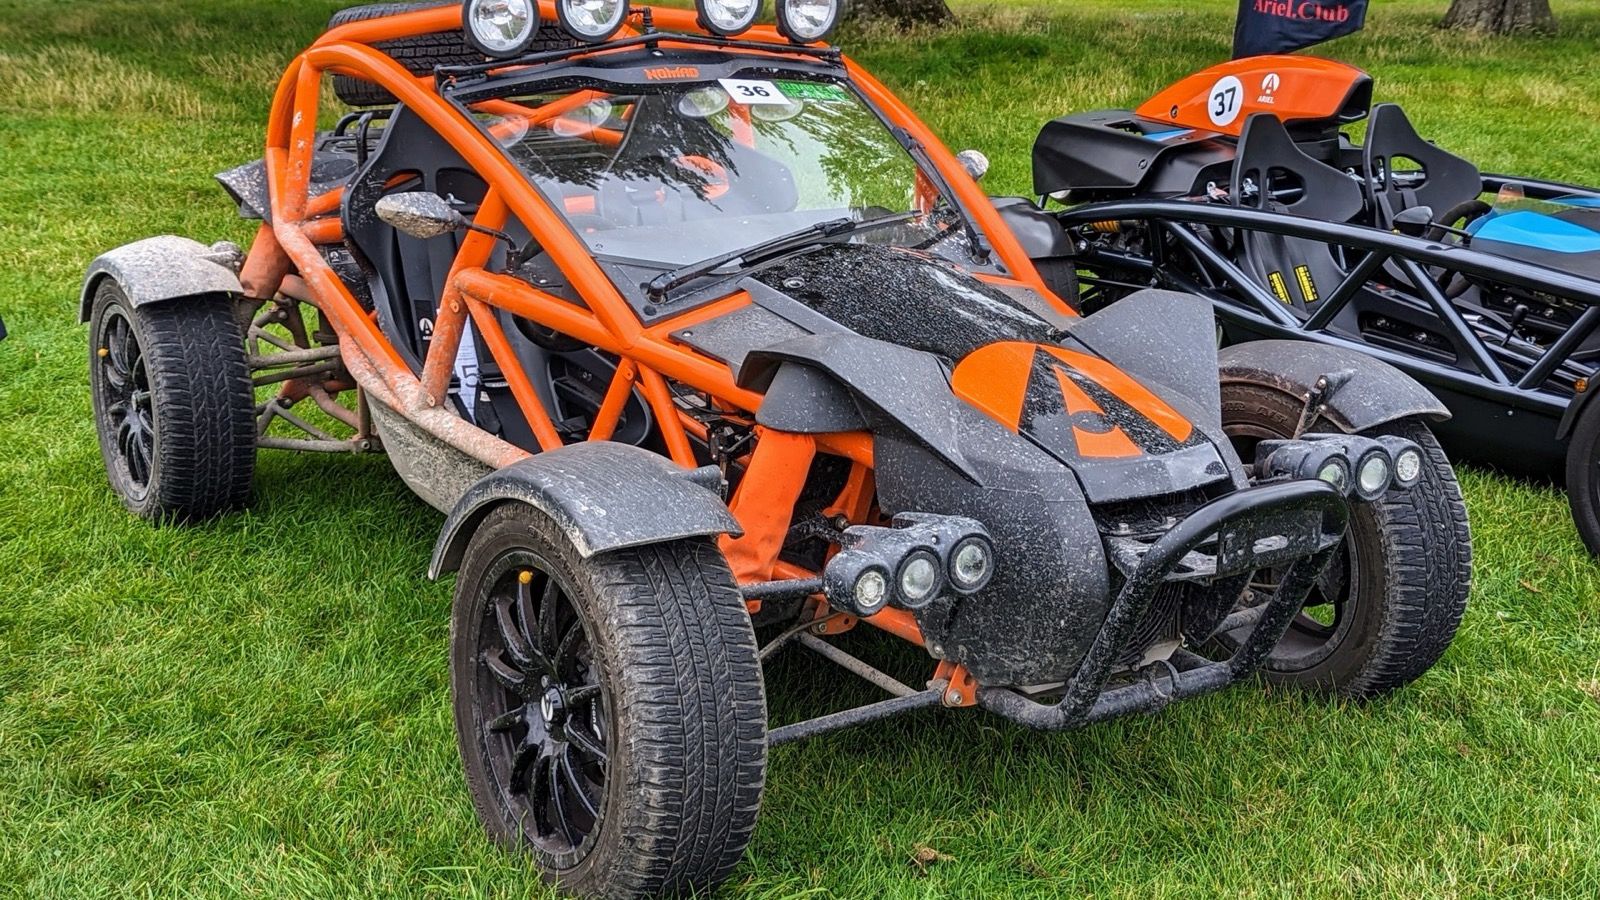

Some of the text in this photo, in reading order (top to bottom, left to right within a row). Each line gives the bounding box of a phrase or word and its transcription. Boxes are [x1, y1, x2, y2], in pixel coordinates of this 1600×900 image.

[1254, 0, 1349, 22] Ariel.Club
[644, 66, 699, 80] NOMAD
[736, 85, 770, 97] 36
[1214, 86, 1237, 116] 37
